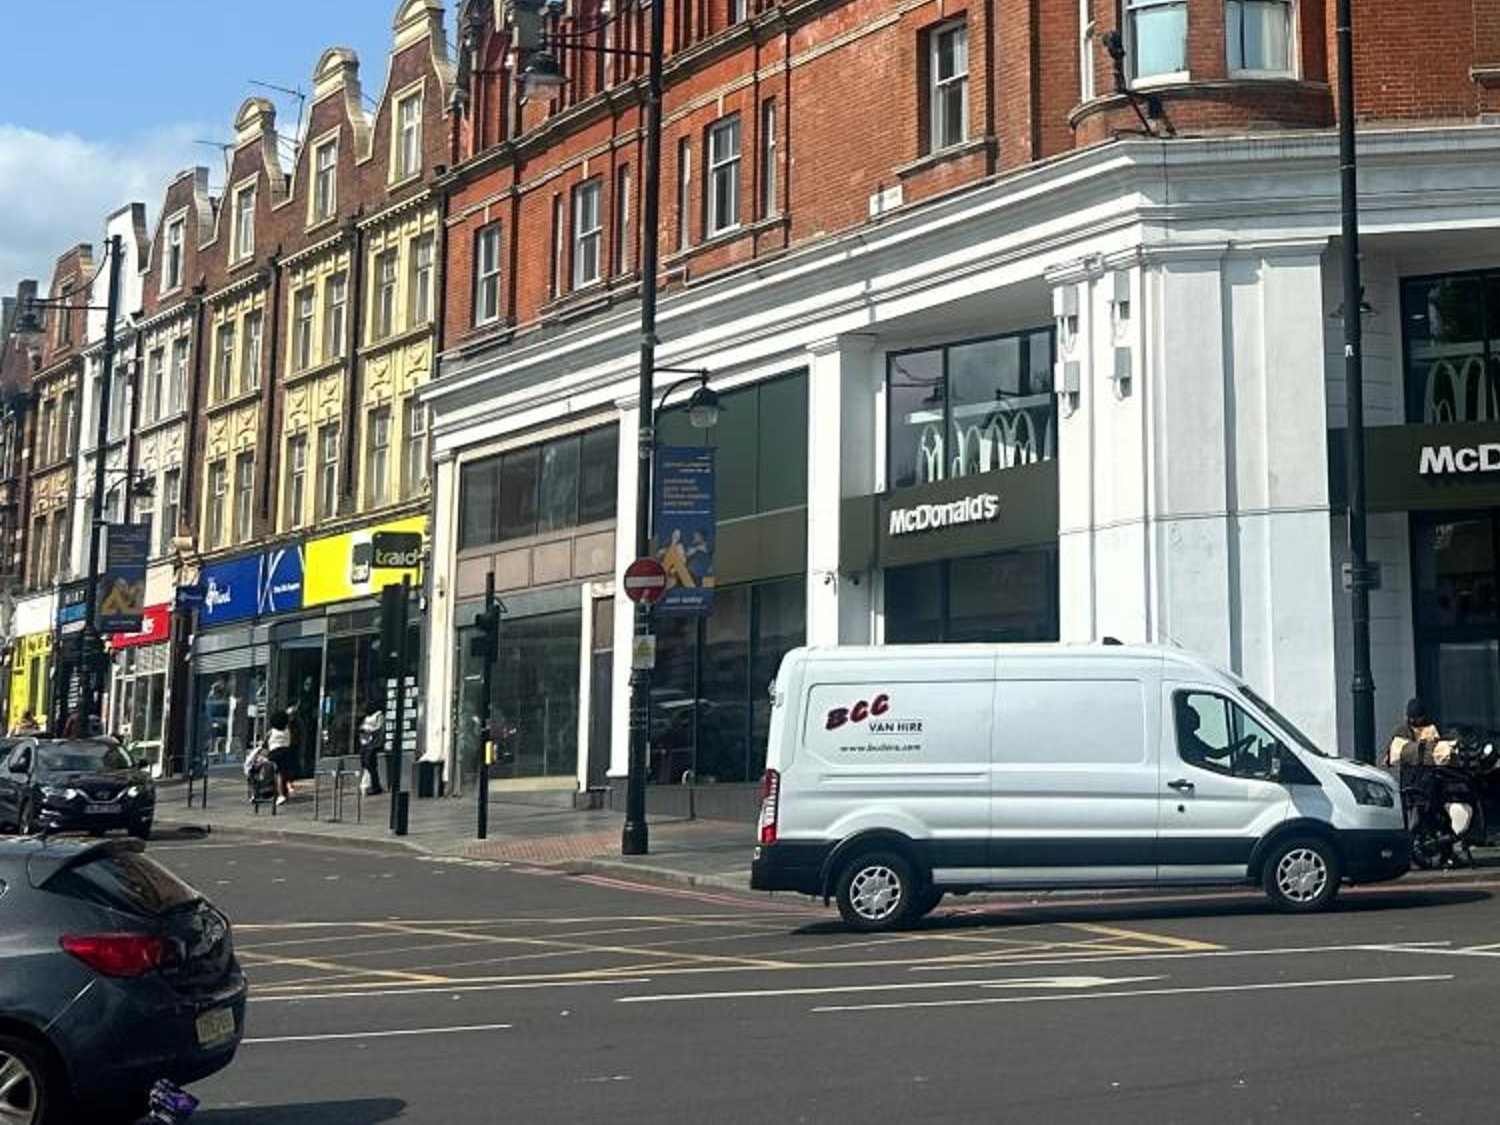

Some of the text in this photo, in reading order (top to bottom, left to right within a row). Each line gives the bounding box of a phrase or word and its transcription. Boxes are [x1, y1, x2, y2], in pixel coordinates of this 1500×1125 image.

[889, 492, 999, 535] McDonald's
[375, 548, 418, 566] traid
[825, 693, 890, 732] BCC
[869, 721, 923, 732] VAN HIRE
